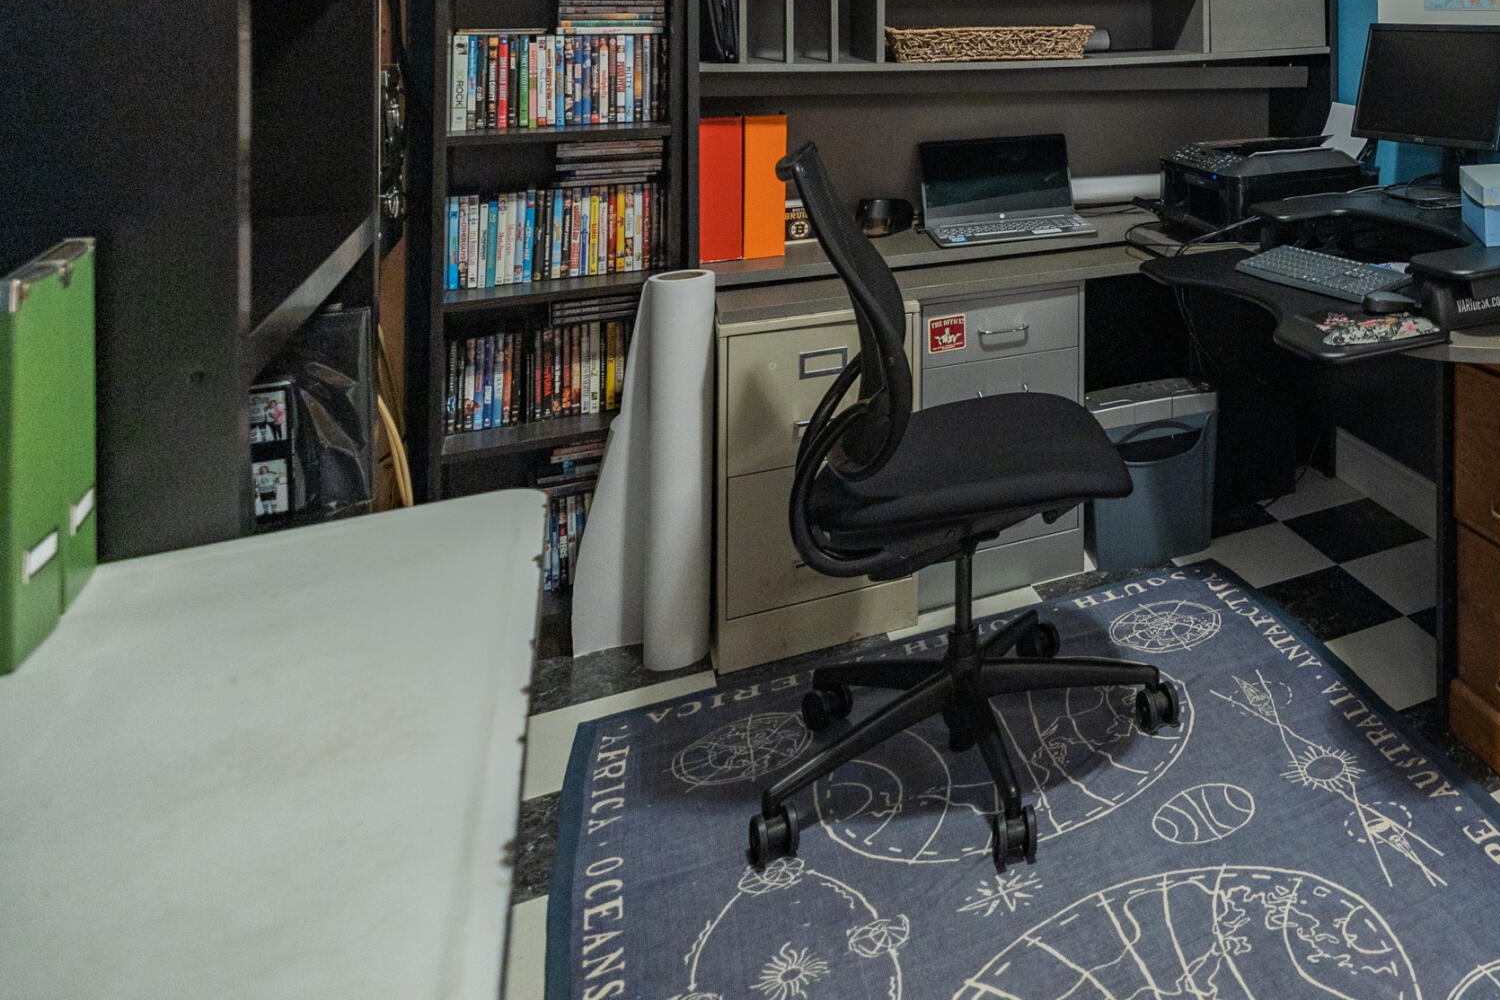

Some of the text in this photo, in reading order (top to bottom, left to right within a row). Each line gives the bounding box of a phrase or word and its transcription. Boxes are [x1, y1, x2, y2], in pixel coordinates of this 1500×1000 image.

[931, 320, 943, 329] THE
[1071, 571, 1186, 610] SOUTH
[587, 733, 632, 836] AFRICA
[1320, 681, 1460, 799] AUSTRALIA
[581, 856, 627, 1000] OCEANS
